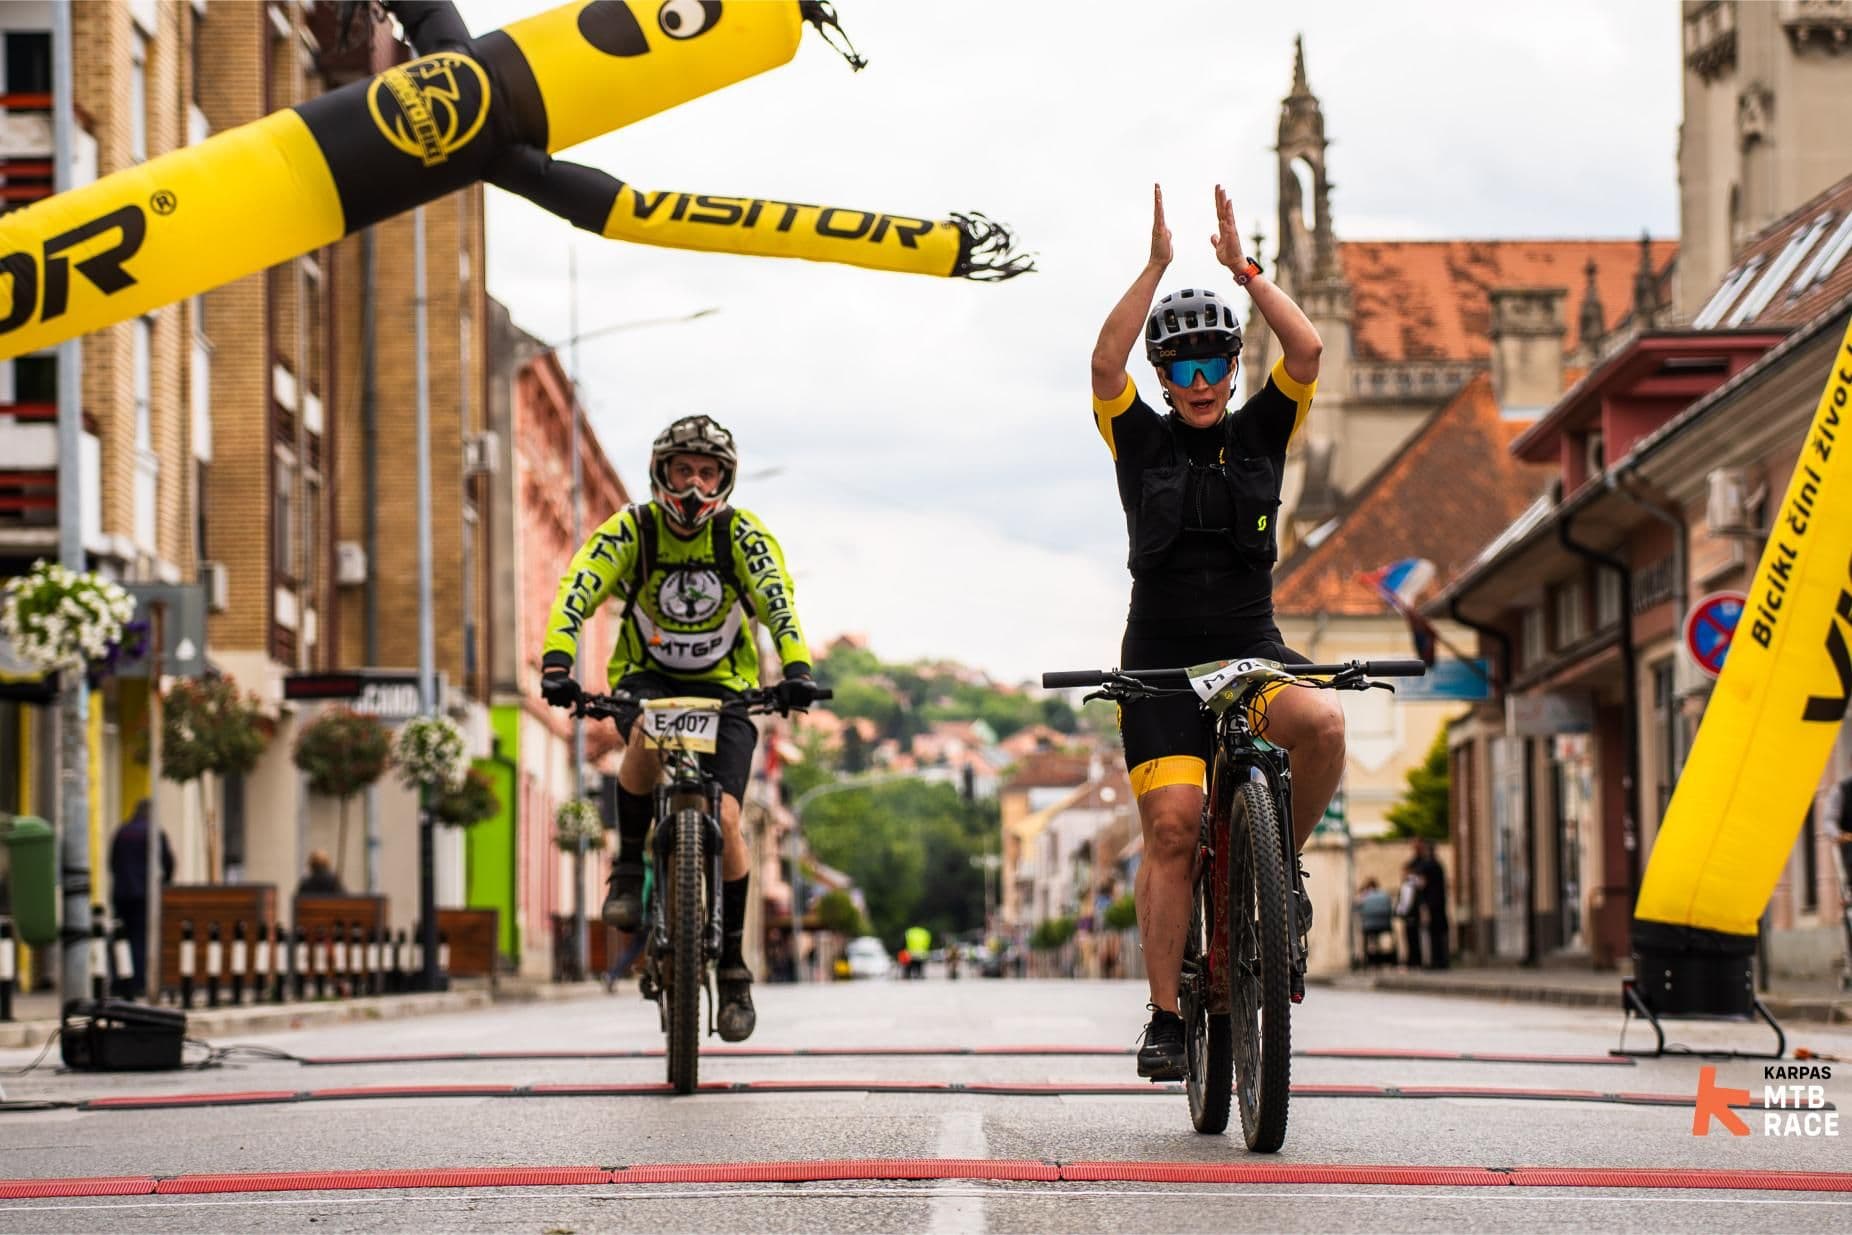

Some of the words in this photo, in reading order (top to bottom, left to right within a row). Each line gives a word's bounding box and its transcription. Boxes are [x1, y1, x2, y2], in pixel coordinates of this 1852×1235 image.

[631, 190, 934, 249] VISITOR
[1751, 542, 1798, 650] Bicikl
[1786, 465, 1822, 537] čini
[1813, 367, 1852, 463] život
[654, 713, 709, 733] E-007
